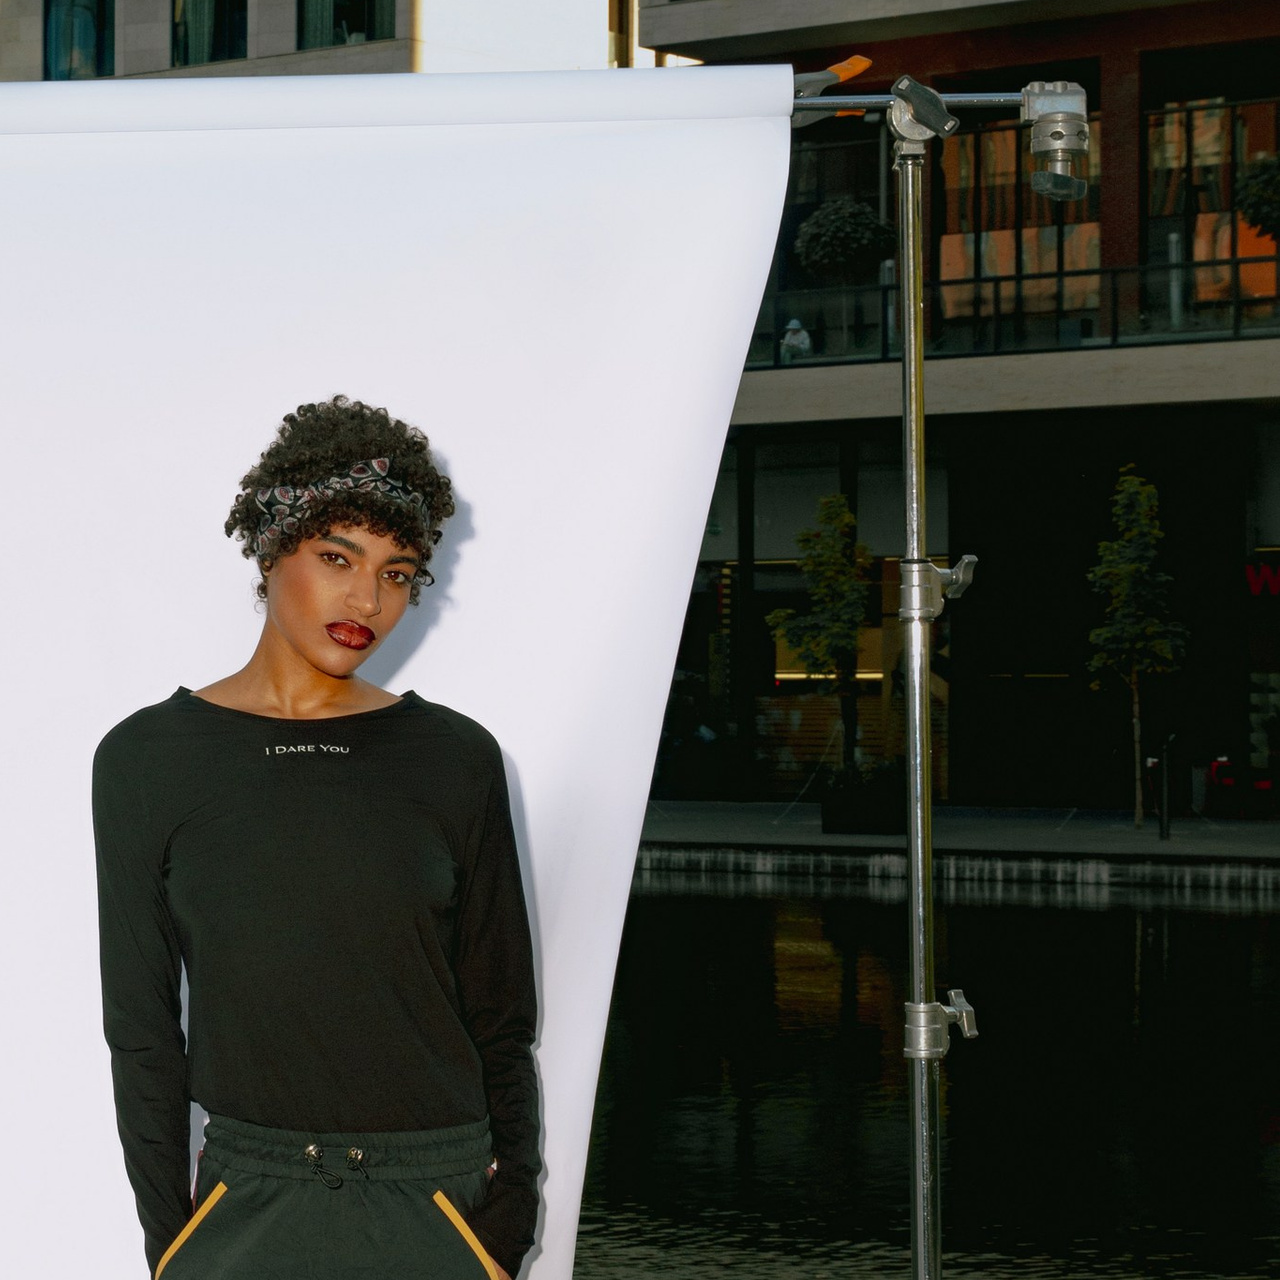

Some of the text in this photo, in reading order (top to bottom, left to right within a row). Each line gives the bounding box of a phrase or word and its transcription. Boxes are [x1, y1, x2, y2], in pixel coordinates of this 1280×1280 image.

[265, 744, 350, 756] I DARE YOU
